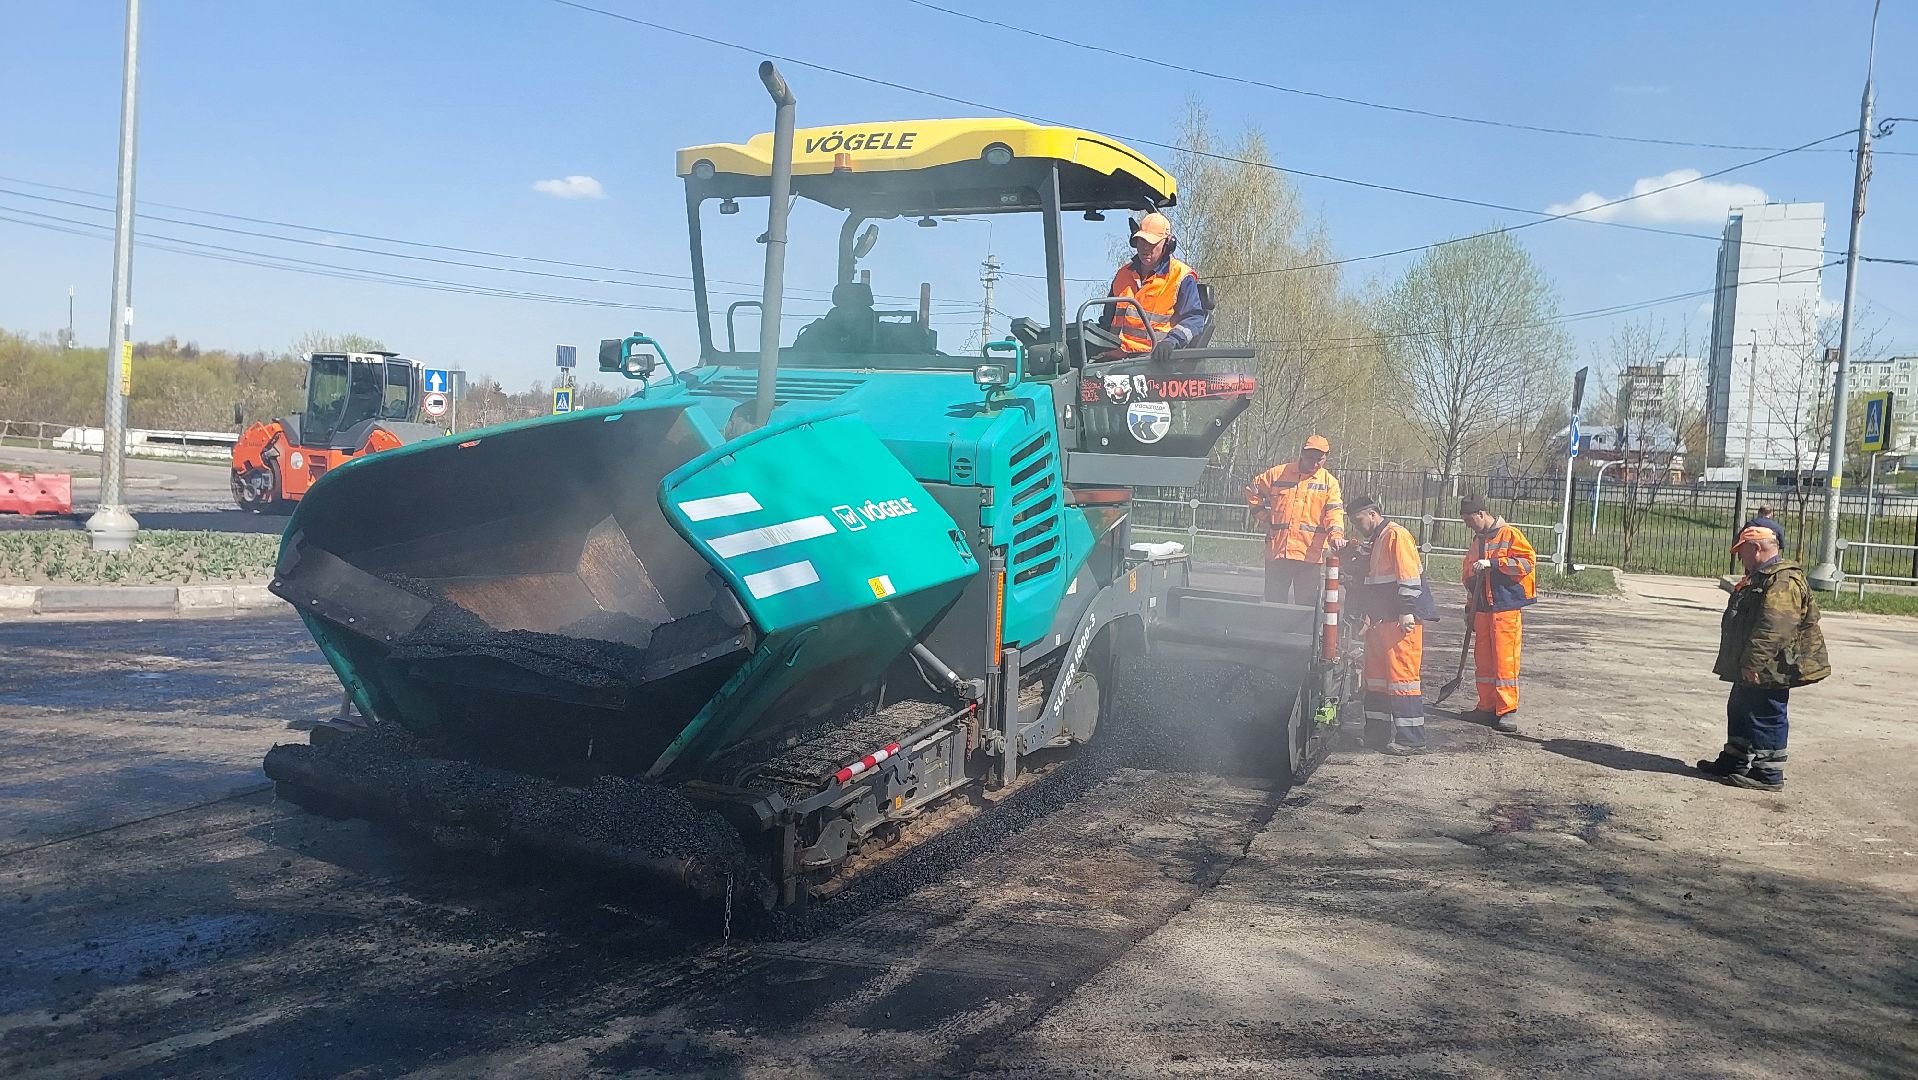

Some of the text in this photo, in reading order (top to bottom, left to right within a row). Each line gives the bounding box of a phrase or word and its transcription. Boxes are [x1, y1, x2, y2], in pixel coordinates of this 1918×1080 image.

[806, 131, 917, 153] VÖGELE
[1159, 379, 1207, 398] JOKER
[857, 497, 918, 522] VÖGELE
[1053, 613, 1096, 717] SUPER 1800-3
